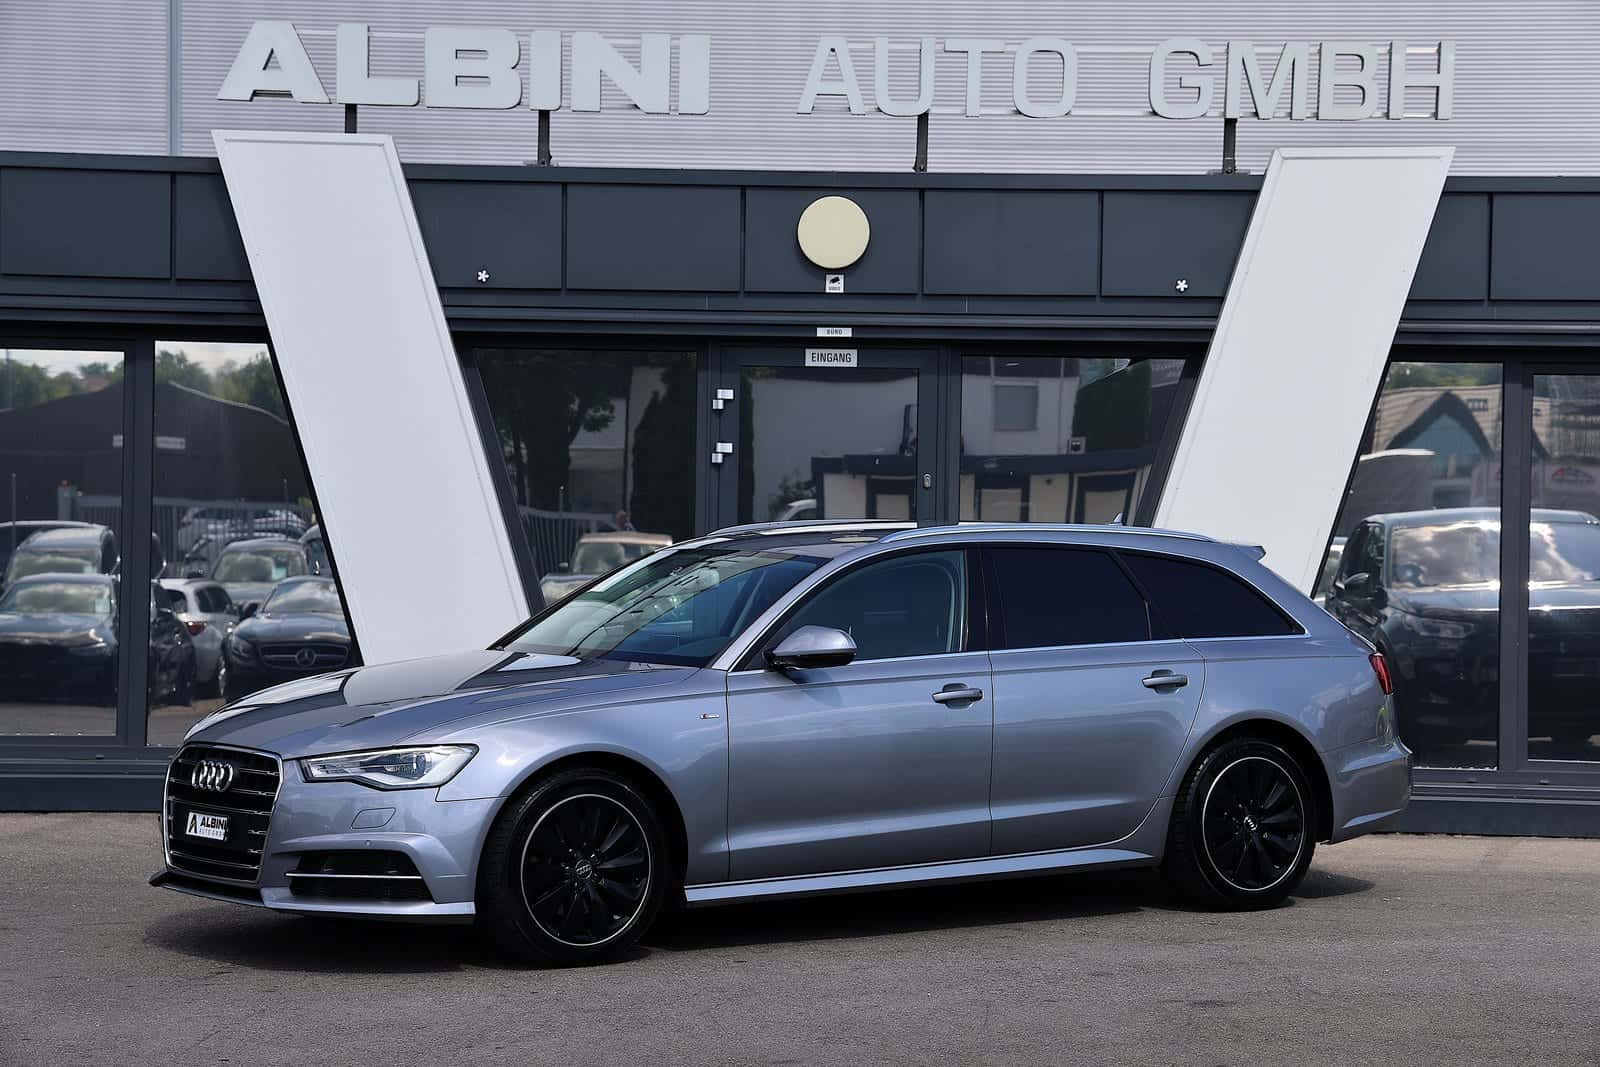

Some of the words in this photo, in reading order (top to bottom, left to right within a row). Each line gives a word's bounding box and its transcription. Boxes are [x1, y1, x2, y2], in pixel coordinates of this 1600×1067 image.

[217, 21, 711, 115] ALBINI
[797, 35, 1078, 118] AUTO
[1148, 38, 1456, 121] GMBH
[811, 352, 852, 363] EINGANG
